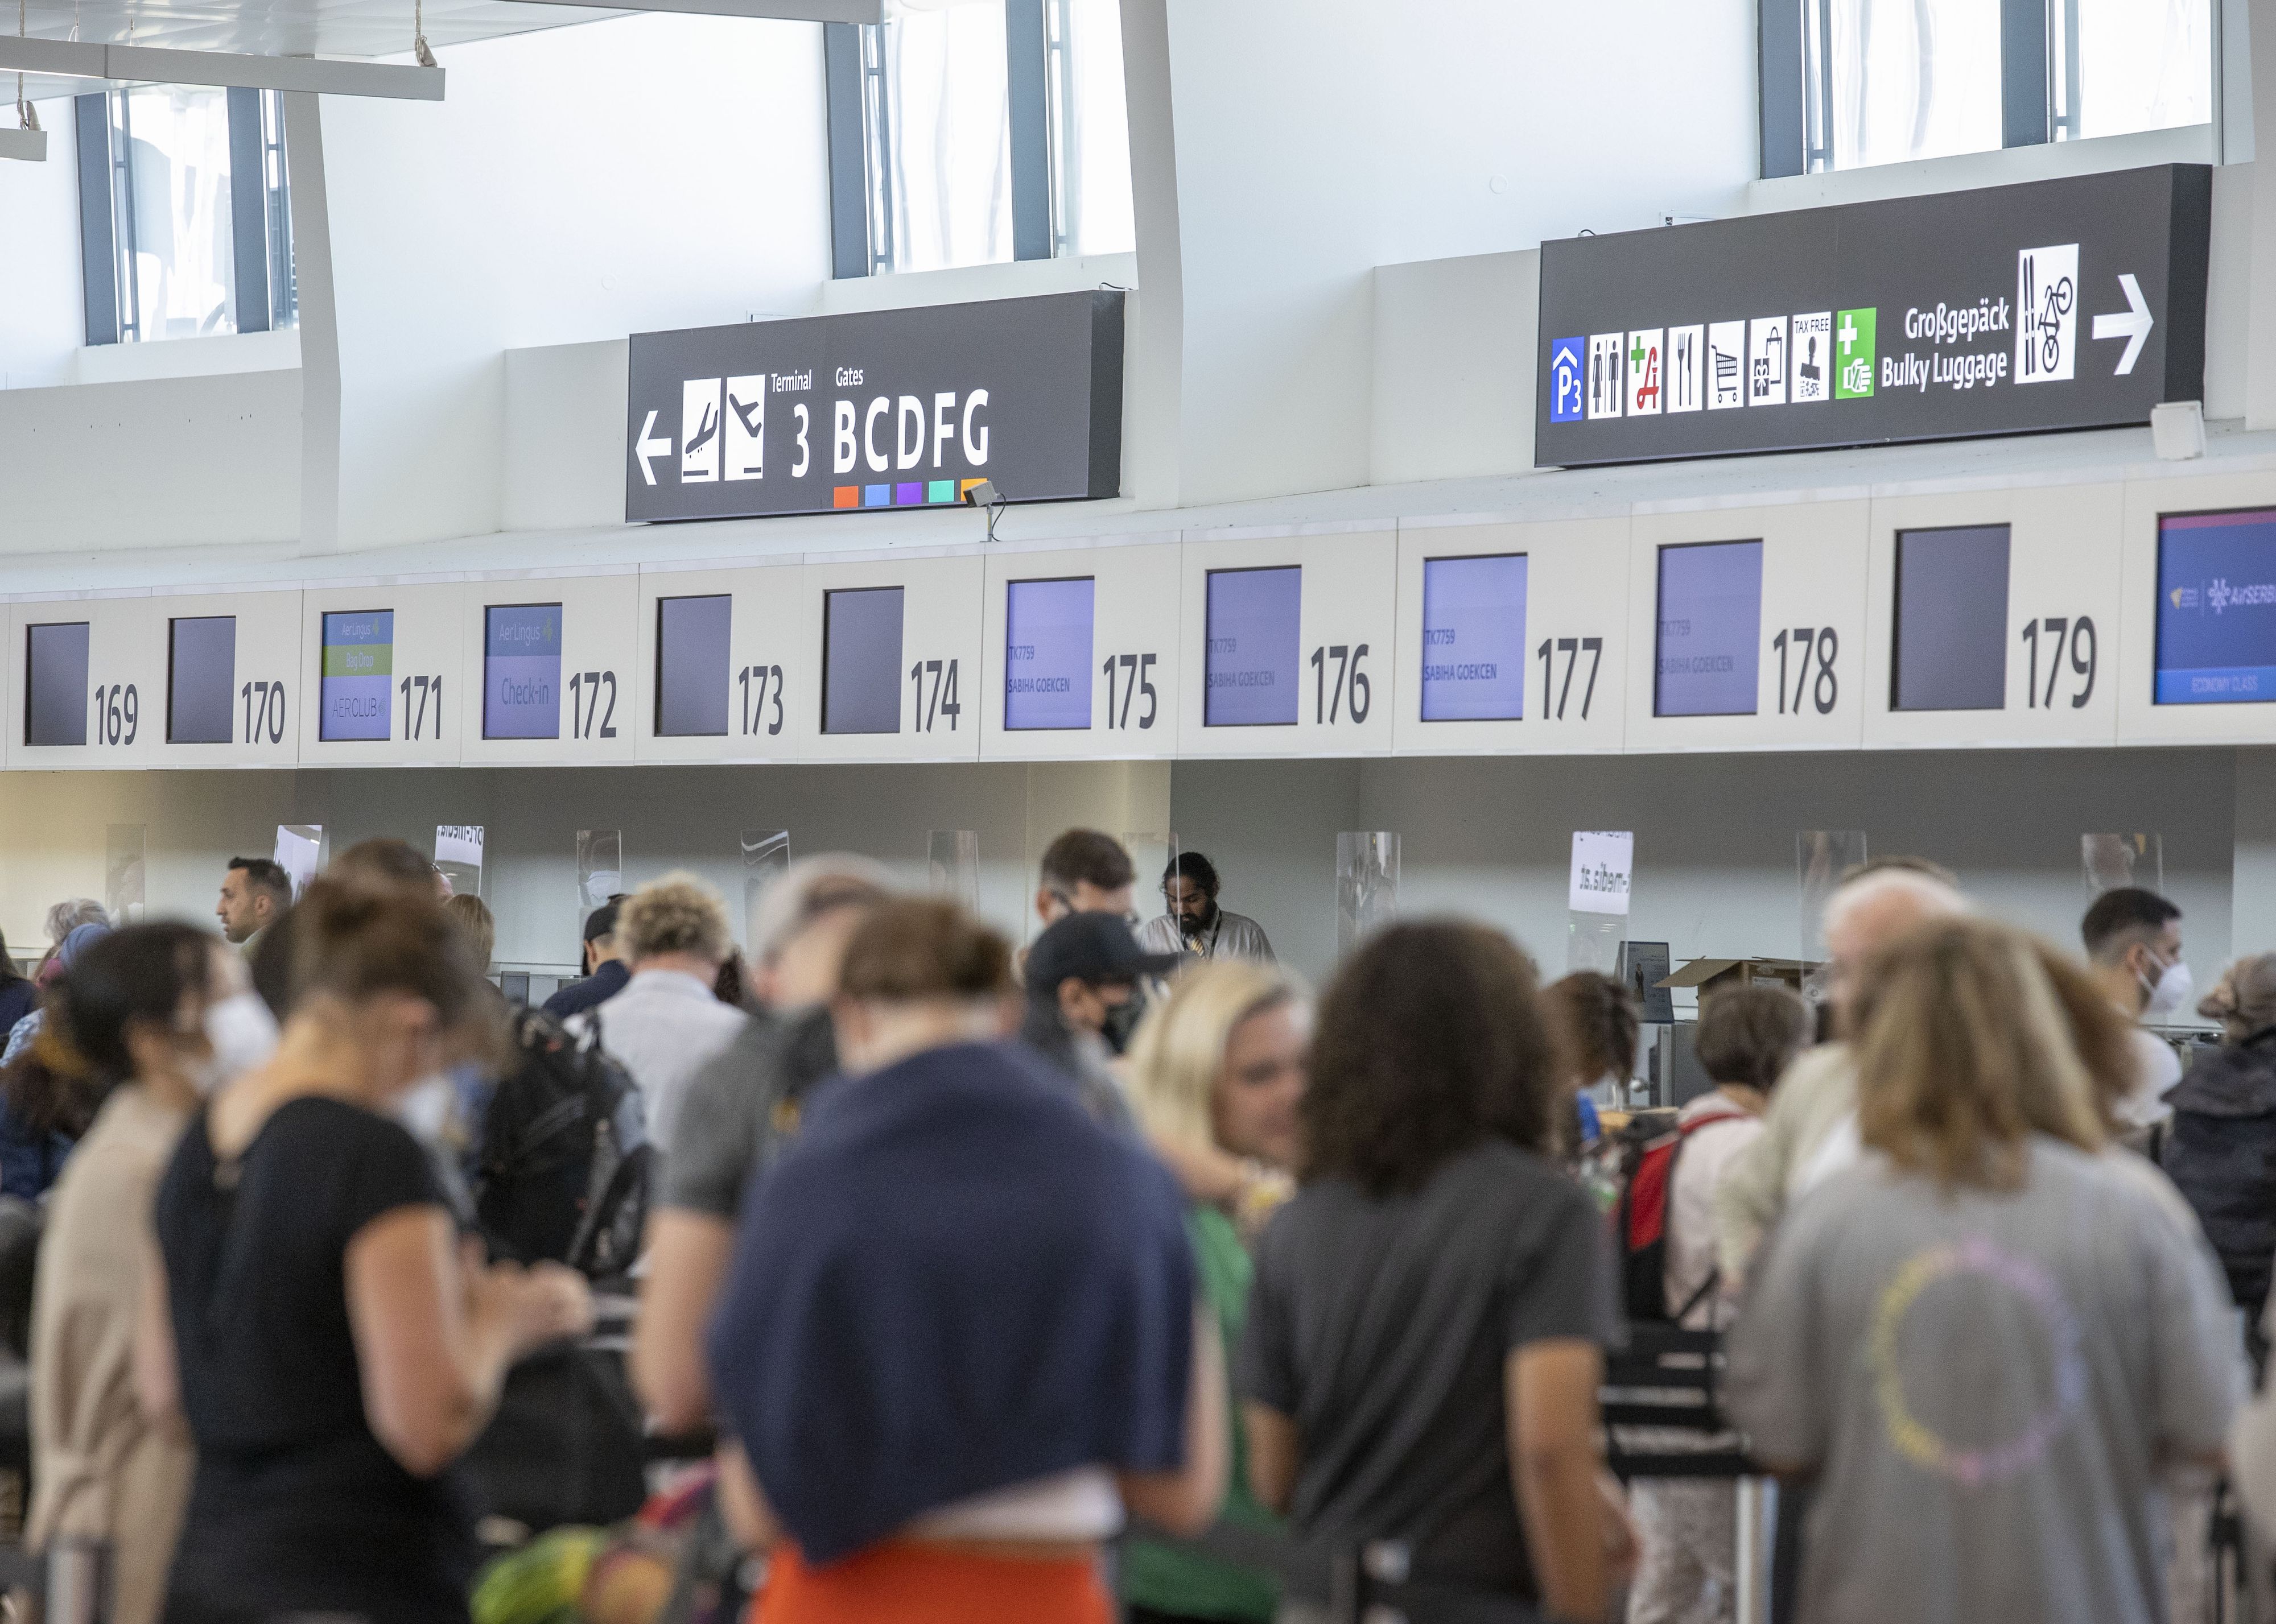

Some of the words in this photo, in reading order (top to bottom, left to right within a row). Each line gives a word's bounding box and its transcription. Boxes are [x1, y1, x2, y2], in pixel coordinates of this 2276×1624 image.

[1795, 320, 1809, 334] TAX
[1810, 318, 1829, 332] FREE
[1904, 297, 2009, 344] Großgepäck
[770, 369, 812, 392] Terminal
[835, 366, 864, 387] Gates
[1882, 353, 1930, 392] Bulky
[1932, 352, 2007, 390] Luggage
[791, 403, 810, 478] 3
[1009, 645, 1034, 660] TK7759
[1424, 629, 1456, 645] TK7759
[2022, 615, 2097, 709] 179
[501, 677, 549, 705] Check-in
[739, 664, 784, 736] 173
[911, 659, 960, 733] 174
[1008, 677, 1034, 693] SABIHA
[1036, 677, 1070, 692] GOEKCEN
[1103, 653, 1157, 730] 175
[1311, 643, 1370, 725] 176
[1424, 665, 1456, 681] SABIHA
[1538, 637, 1602, 720] 177
[1774, 627, 1837, 714] 178
[95, 684, 138, 746] 169
[242, 680, 285, 745] 170
[401, 675, 442, 741] 171
[570, 671, 617, 739] 172
